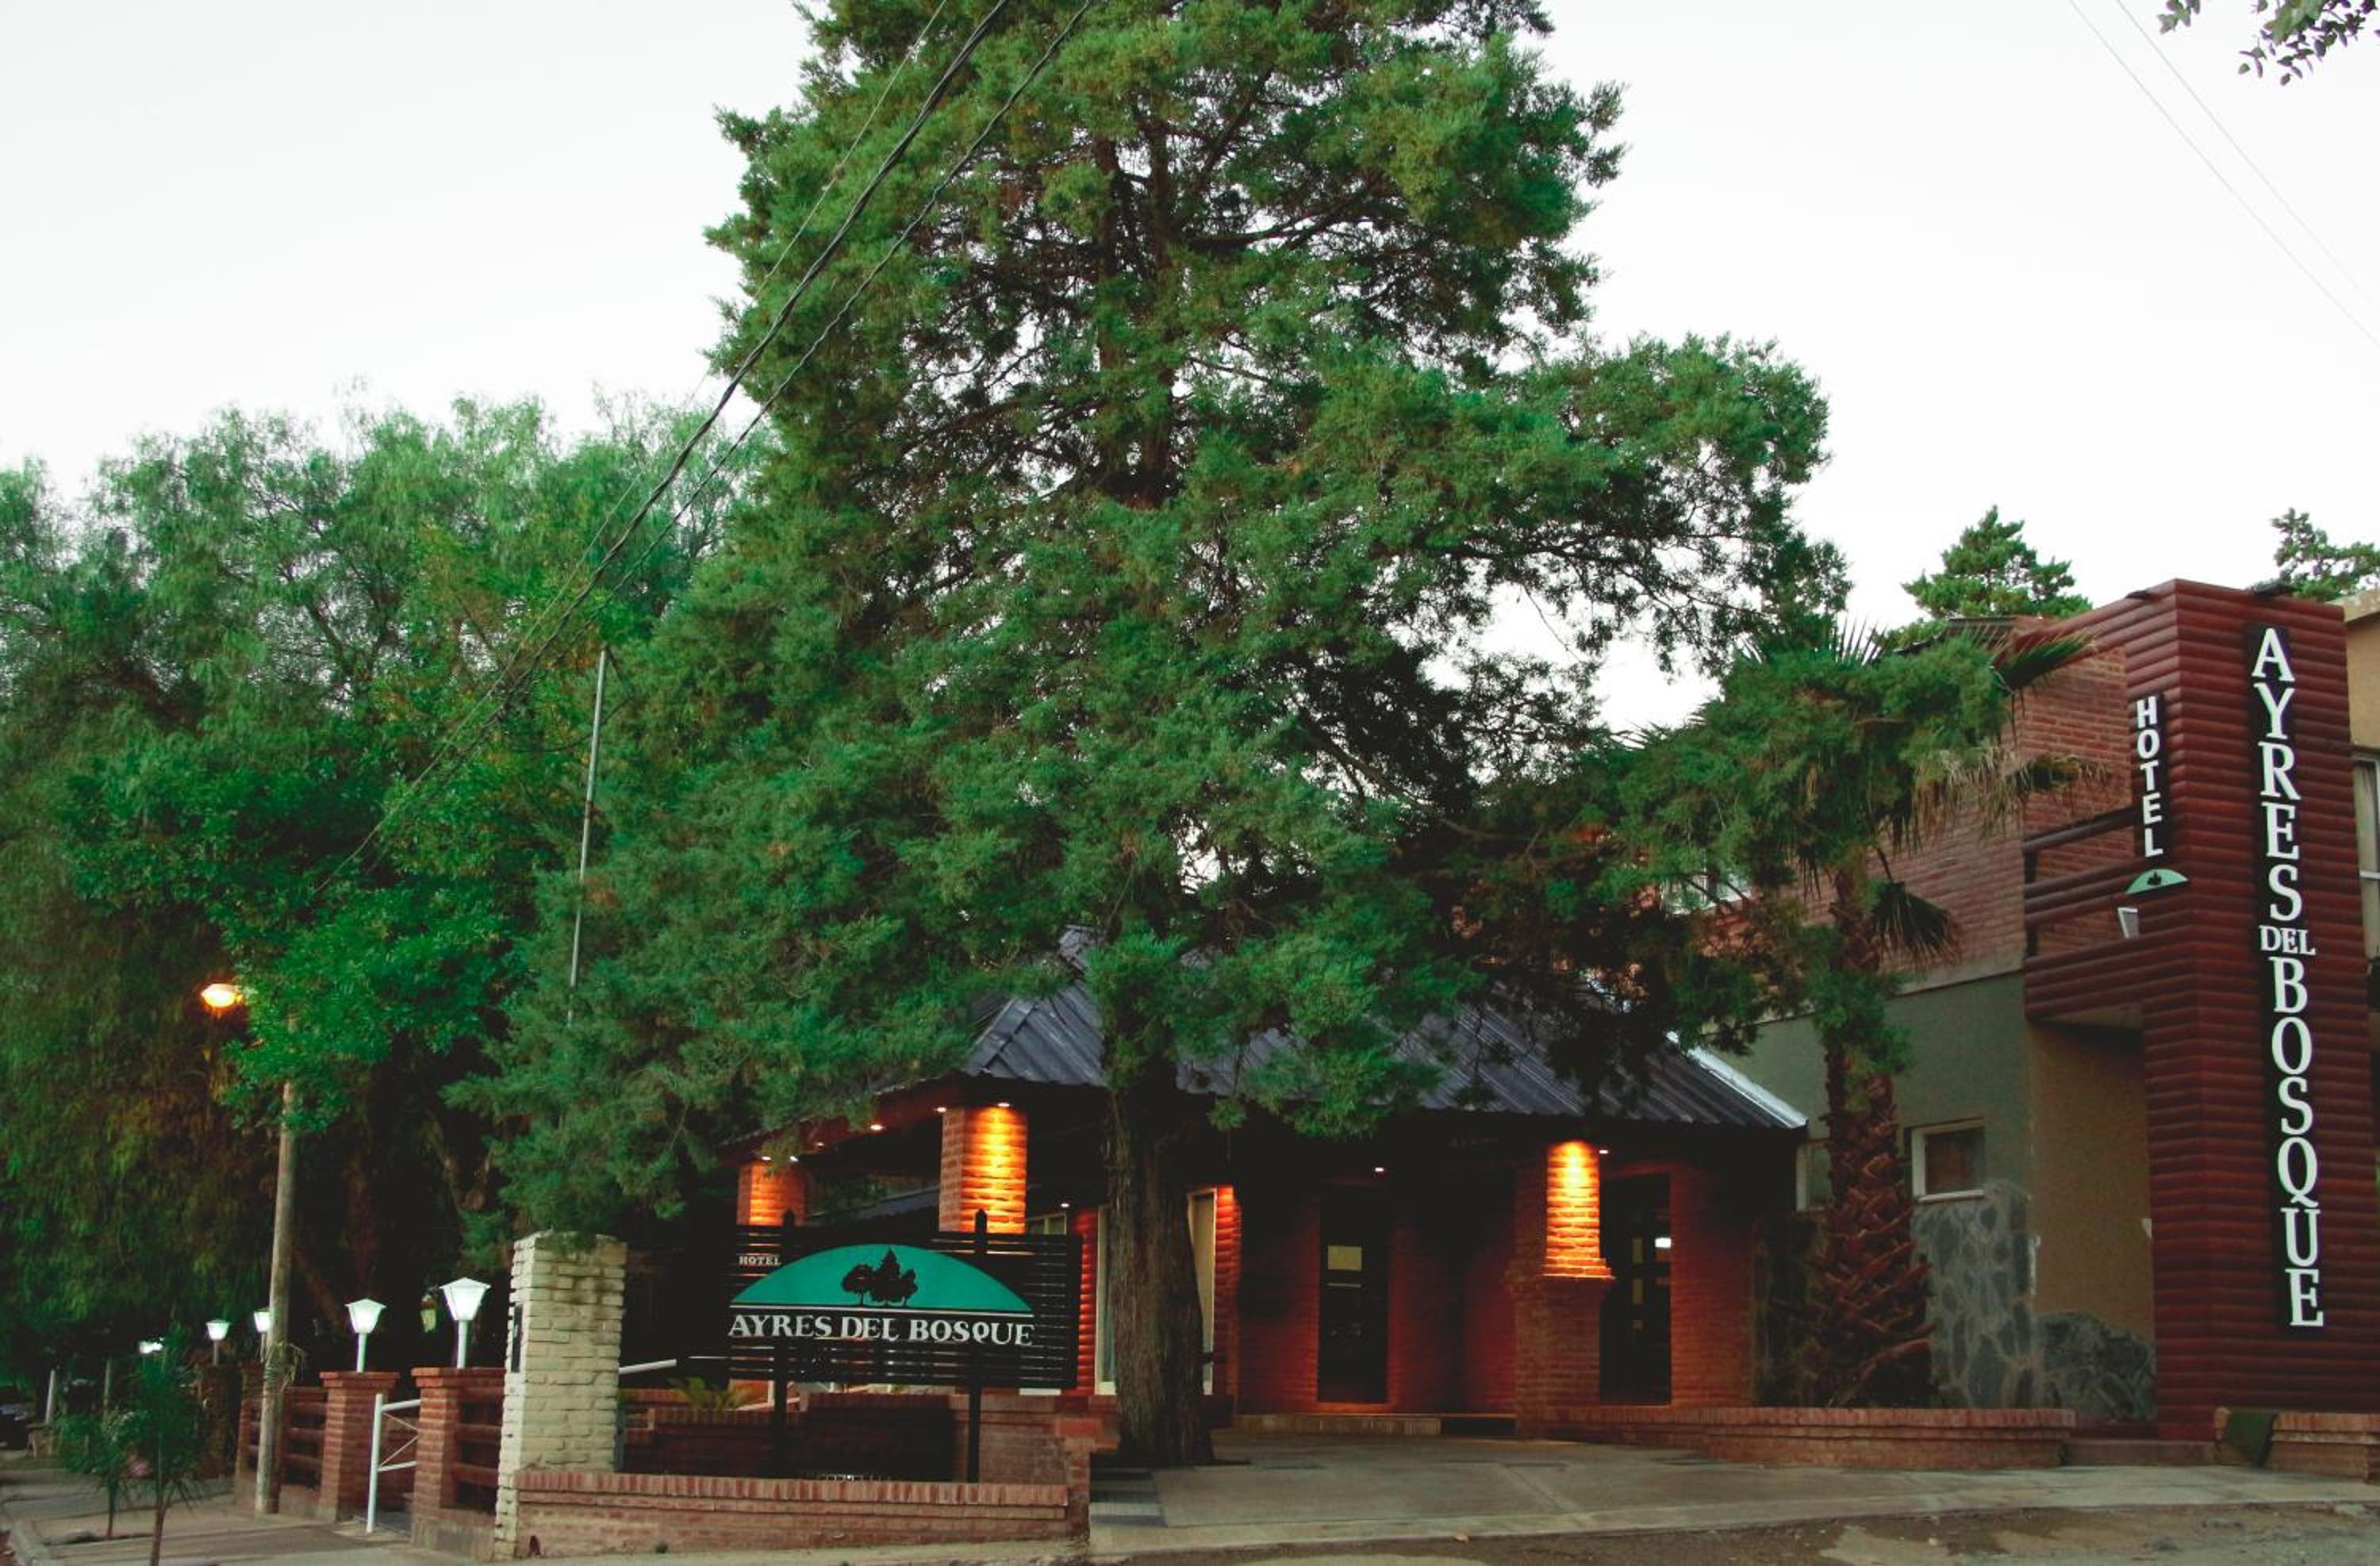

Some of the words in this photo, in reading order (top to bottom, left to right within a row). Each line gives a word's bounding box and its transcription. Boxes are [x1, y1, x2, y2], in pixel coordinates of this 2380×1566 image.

[2136, 695, 2163, 858] HOTEL
[2251, 628, 2302, 922] AYRES
[2259, 924, 2316, 955] DEL
[2268, 956, 2324, 1327] BOSQUE
[739, 1255, 781, 1266] HOTEL
[727, 1315, 832, 1338] AYRES
[840, 1317, 900, 1341] DEL
[908, 1319, 1035, 1346] BOSQUE
